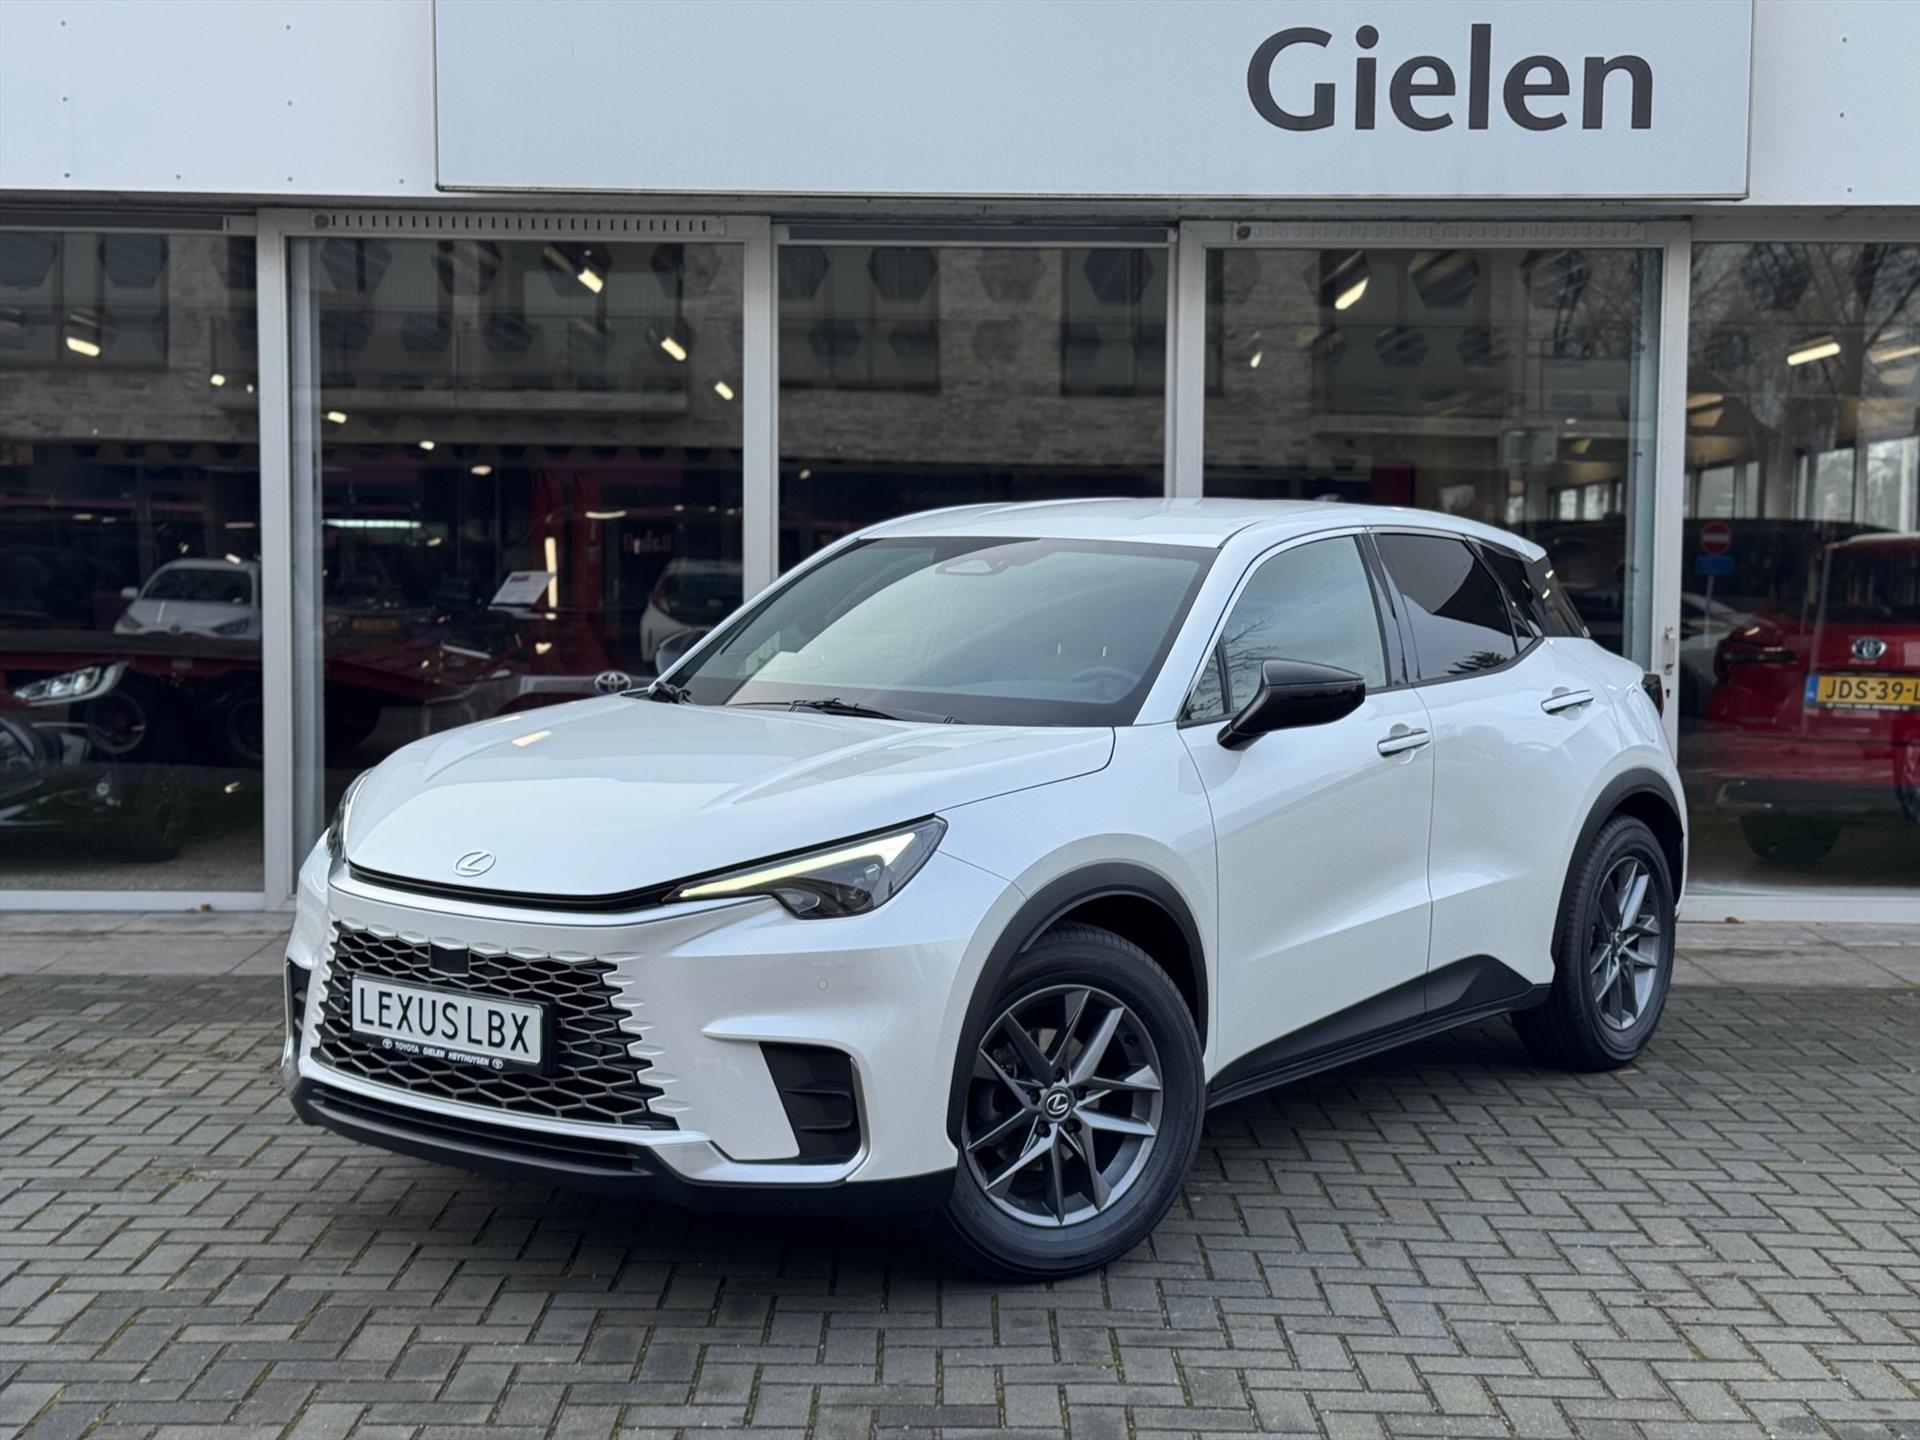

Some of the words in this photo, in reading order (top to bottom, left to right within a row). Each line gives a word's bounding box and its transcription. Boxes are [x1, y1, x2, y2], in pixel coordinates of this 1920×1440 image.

[1247, 23, 1653, 132] Gielen
[395, 1041, 420, 1054] TOYOTA
[423, 1046, 446, 1058] GIELEN
